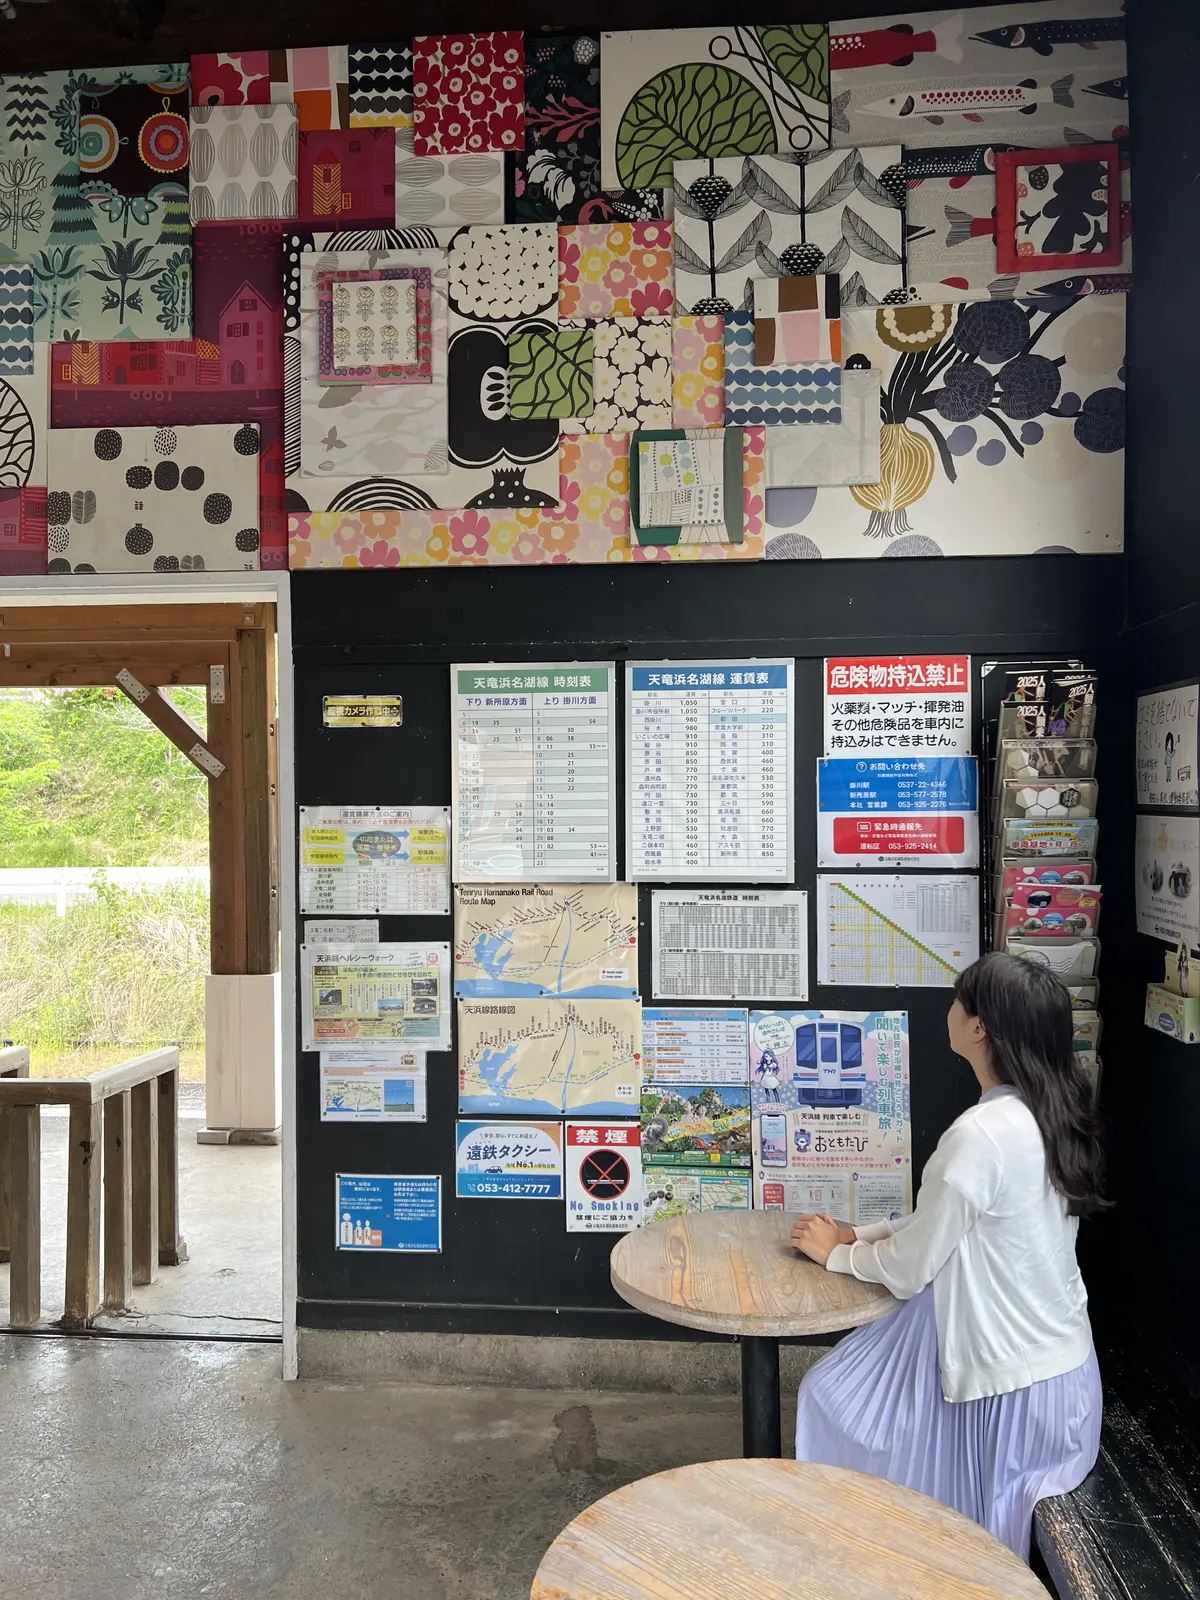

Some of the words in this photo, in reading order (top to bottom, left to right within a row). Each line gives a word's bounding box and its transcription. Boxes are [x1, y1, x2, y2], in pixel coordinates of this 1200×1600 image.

[648, 673, 725, 686] 天竜浜名湖線
[730, 672, 769, 684] 運賃表
[830, 663, 965, 688] 危険物持込禁止
[474, 676, 549, 689] 天竜浜名湖線
[554, 675, 591, 687] 時刻表
[466, 698, 481, 706] 下り
[485, 697, 527, 706] 新所原方面
[544, 697, 559, 705] 上り
[563, 696, 597, 705] 掛川方面
[831, 700, 964, 715] 火薬類・マッチ・揮発油
[831, 717, 964, 731] その他危険品を車内に
[831, 734, 957, 748] 持込みはできません。
[870, 762, 925, 771] お問い合わせ先
[888, 842, 937, 850] 053-925-2414
[459, 888, 483, 898] Tenryu
[483, 888, 520, 896] Hamanako
[521, 888, 534, 896] Rail
[536, 888, 554, 896] Road
[459, 897, 479, 905] Route
[480, 897, 496, 906] Map
[464, 1006, 516, 1015] 天浜線路線図
[576, 1129, 628, 1144] 禁煙
[815, 1135, 869, 1153] おともたび
[466, 1144, 551, 1161] 遠鉄タクシー
[477, 1184, 550, 1194] 053-412-7777
[570, 1201, 583, 1211] No
[591, 1201, 640, 1212] Smoking
